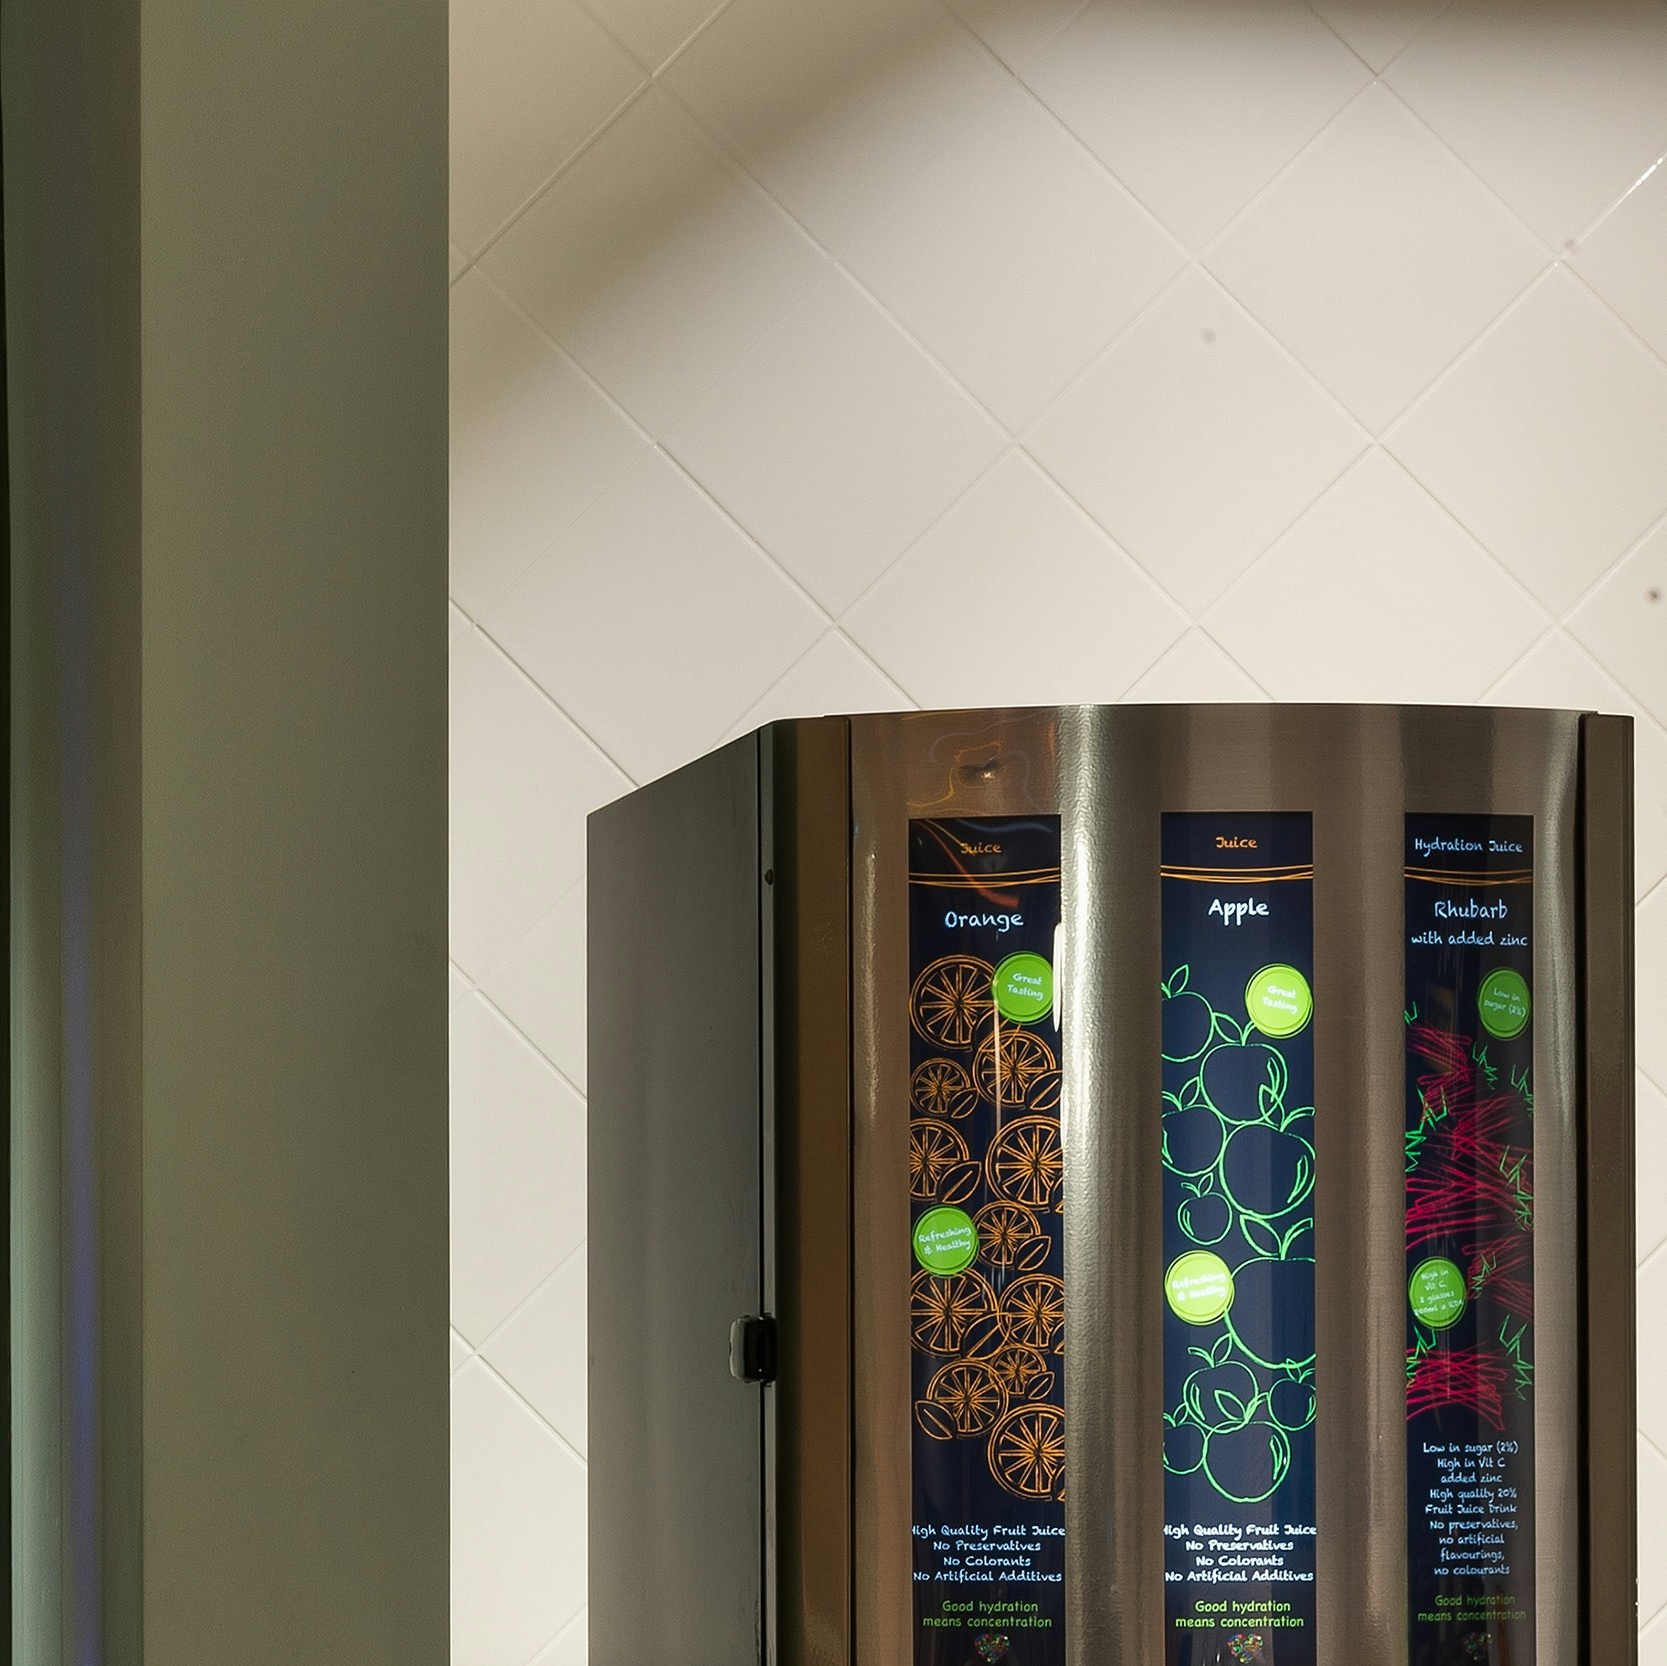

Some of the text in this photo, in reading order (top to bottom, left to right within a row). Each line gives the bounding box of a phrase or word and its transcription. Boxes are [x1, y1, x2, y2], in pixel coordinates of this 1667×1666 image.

[960, 842, 1002, 855] Juice
[1215, 836, 1258, 849] Juice
[1415, 837, 1524, 857] Hydration Juice
[1208, 897, 1269, 926] Apple
[1434, 898, 1508, 919] Rhubarb
[944, 911, 1024, 932] Orange
[1411, 930, 1528, 946] with added zinc
[1013, 973, 1042, 986] Great
[1007, 984, 1044, 1000] Tasting
[1423, 1443, 1445, 1453] Low
[1449, 1443, 1460, 1452] in
[1464, 1444, 1493, 1456] sugar
[1437, 1458, 1505, 1472] High in Vit C
[1441, 1474, 1503, 1484] added zinc
[1430, 1489, 1454, 1503] High
[1457, 1488, 1495, 1504] quality
[1425, 1503, 1517, 1515] Fruit Juice Drink
[1430, 1520, 1445, 1530] No
[941, 1525, 988, 1541] Quality
[993, 1525, 1027, 1536] Fruit
[1032, 1525, 1066, 1536] Juice
[1193, 1524, 1243, 1541] Quality
[1246, 1524, 1280, 1536] Fruit
[1284, 1524, 1317, 1536] Juice
[933, 1540, 1041, 1551] No Preservatives
[1186, 1539, 1294, 1551] No Preservatives
[1439, 1534, 1505, 1547] no artificial
[943, 1555, 1031, 1567] No Colorants
[1195, 1555, 1284, 1567] No Colorants
[1164, 1568, 1314, 1584] No Artificial Additives
[1434, 1564, 1510, 1575] no colourants
[913, 1569, 1062, 1584] No Artificial Additives
[942, 1600, 1038, 1615] Good hydration
[1195, 1600, 1291, 1615] Good hydration
[1435, 1594, 1515, 1609] Good hydration
[923, 1616, 1052, 1628] means concentration
[1175, 1616, 1304, 1628] means concentration
[1417, 1609, 1527, 1622] means concentration
